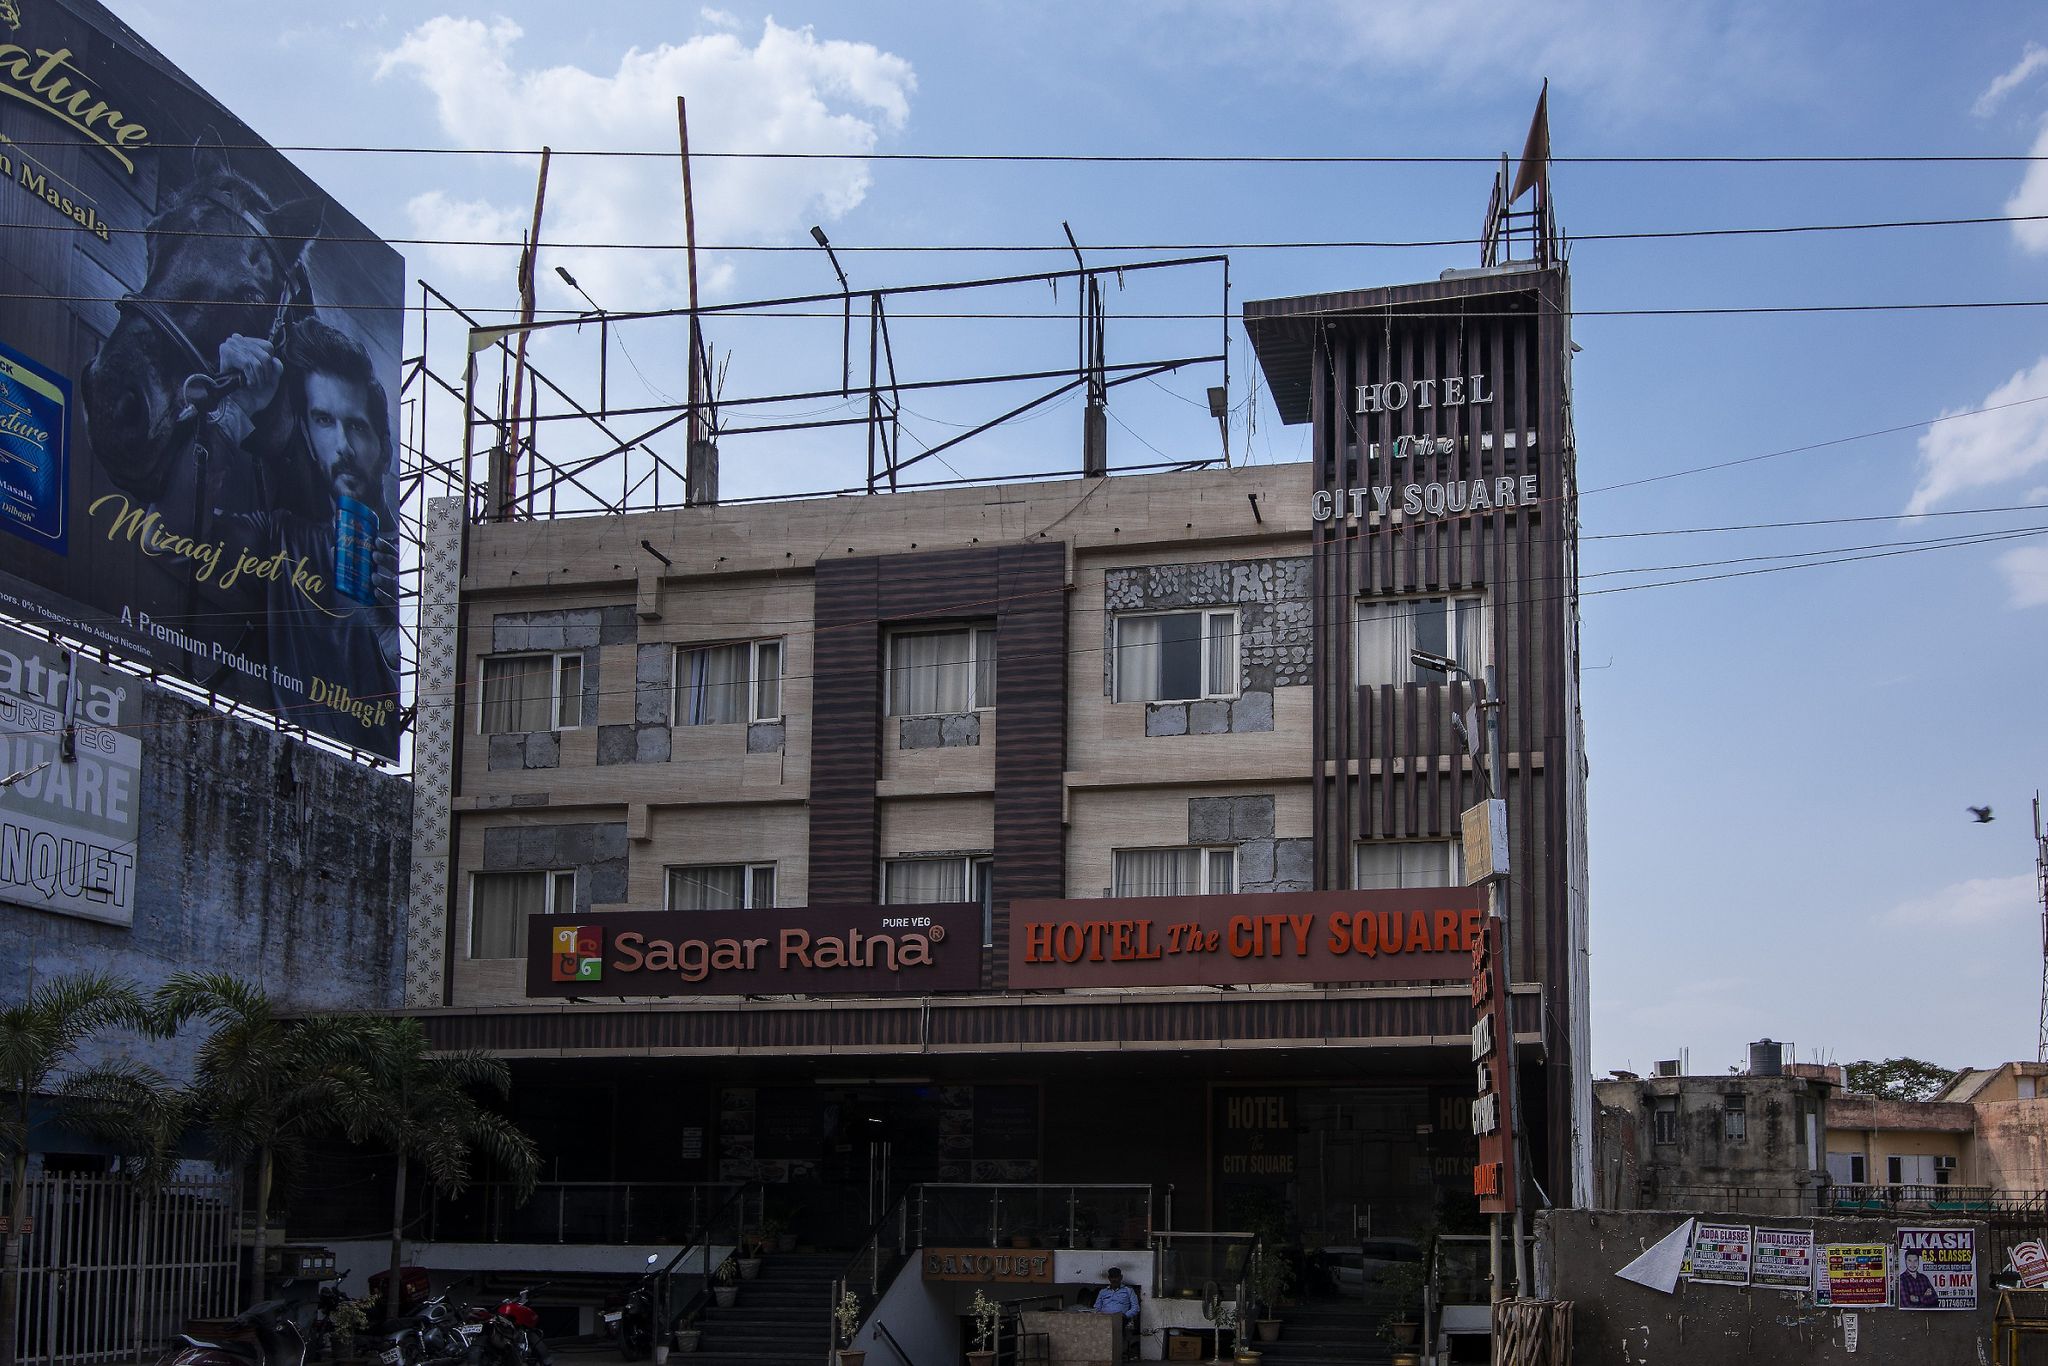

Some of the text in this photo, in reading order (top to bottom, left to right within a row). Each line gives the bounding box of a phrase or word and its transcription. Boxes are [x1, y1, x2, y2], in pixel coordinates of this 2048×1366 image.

[20, 162, 109, 241] Masala
[1355, 374, 1493, 414] HOTEL
[1395, 434, 1455, 458] The
[1312, 475, 1538, 521] CITY SQUARE
[88, 494, 224, 582] Mizaaj
[219, 547, 297, 590] jeet
[291, 556, 354, 618] ka
[22, 599, 35, 612] 0%
[36, 604, 71, 626] Tobacco
[81, 622, 93, 633] No
[94, 628, 119, 644] Added
[120, 638, 153, 657] Nicotine.
[121, 605, 133, 628] A
[140, 611, 208, 657] Premium
[213, 642, 268, 681] Product
[272, 666, 304, 695] from
[882, 917, 932, 928] PURE VEG
[1024, 919, 1161, 963] HOTEL
[1167, 923, 1220, 955] The
[1228, 914, 1314, 957] CITY
[1328, 909, 1483, 958] SQUARE
[613, 931, 768, 982] Sagar
[1228, 1096, 1289, 1129] HOTEL
[1223, 1155, 1294, 1174] CITY SQUARE
[1435, 1156, 1461, 1175] CITY
[1720, 1230, 1749, 1242] CLASSES
[1782, 1234, 1811, 1246] CLASSES
[1901, 1233, 1971, 1249] AKASH
[927, 1254, 1048, 1280] BANQUET
[1922, 1249, 1972, 1262] G.S. CLASSES
[1933, 1274, 1973, 1287] 16 MAY
